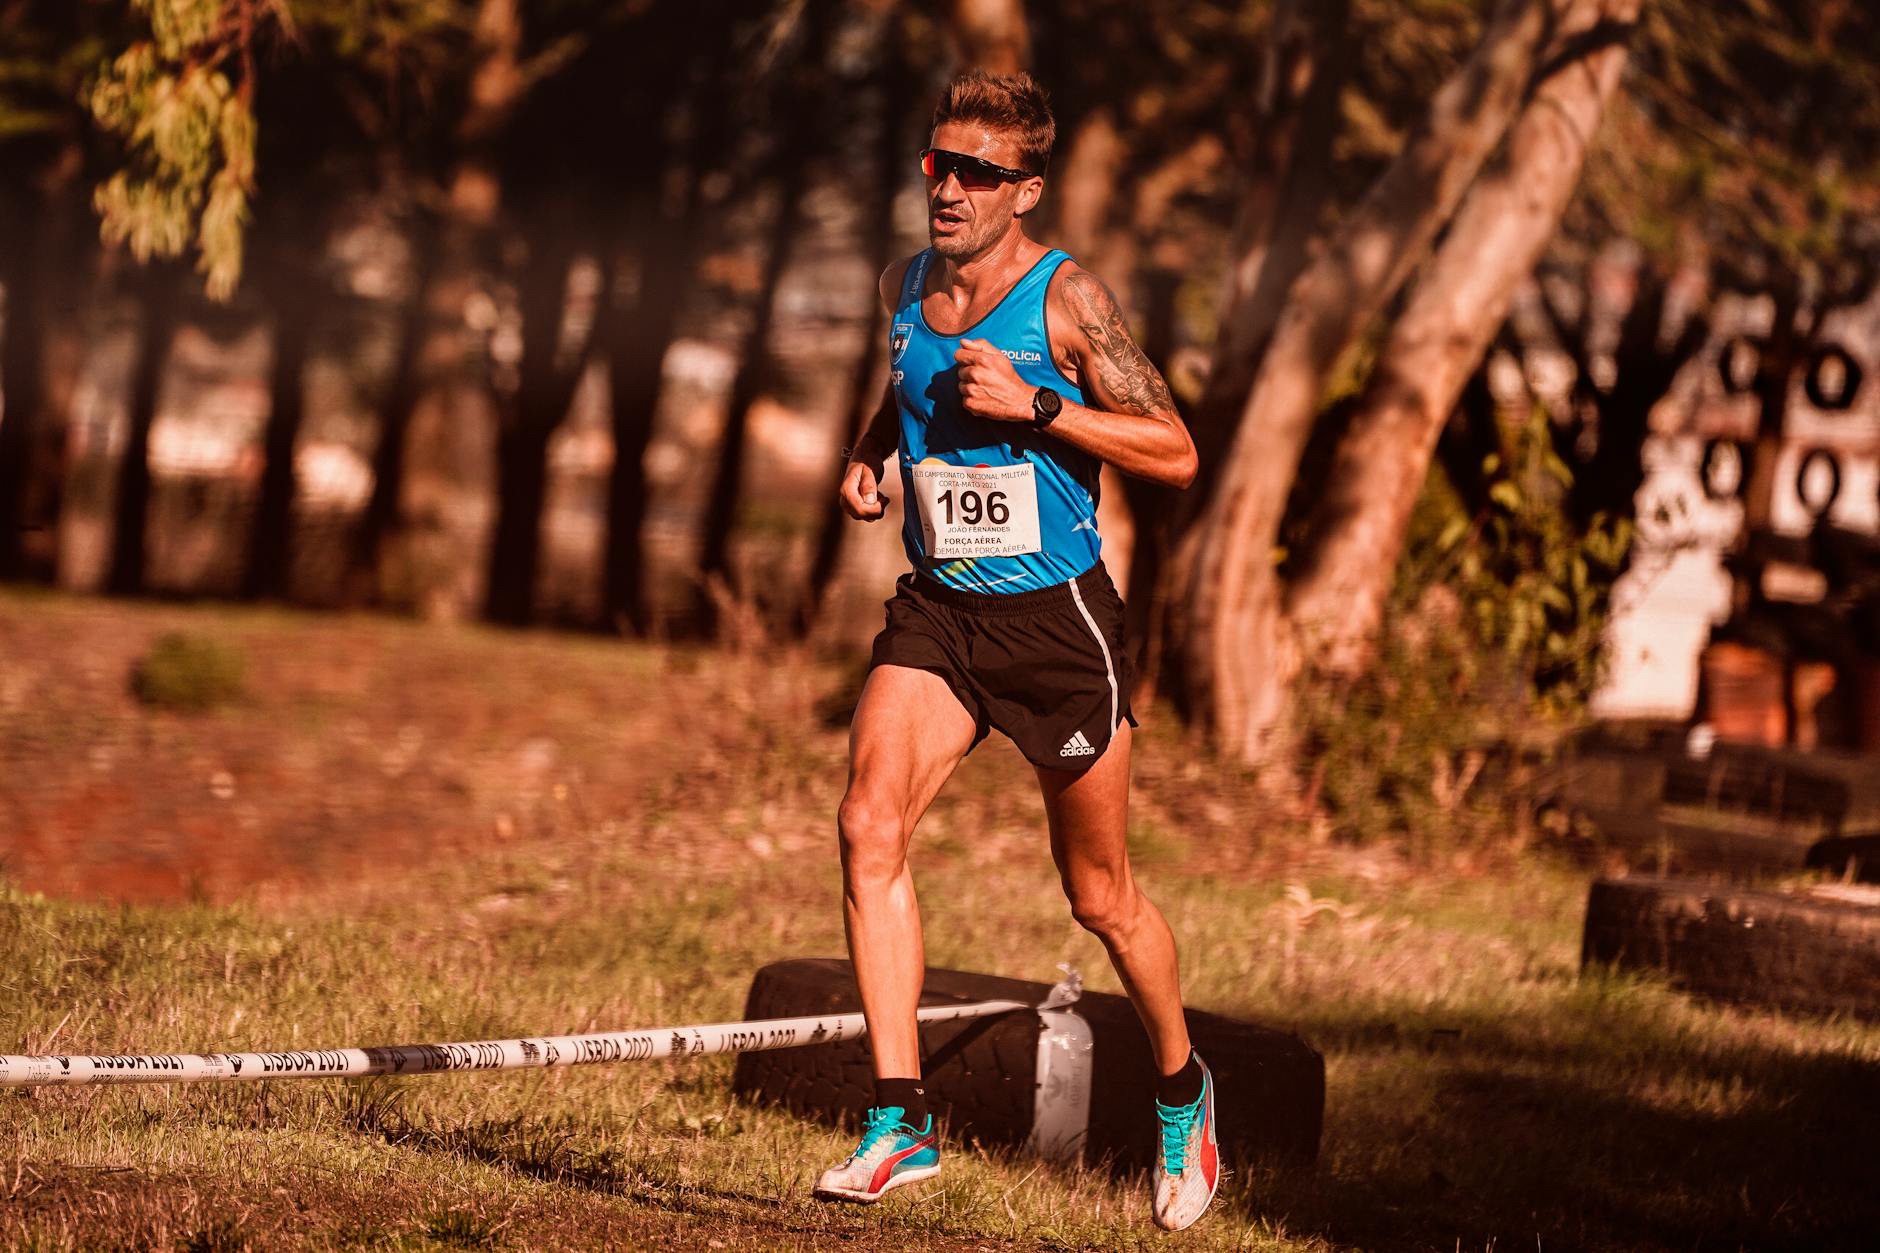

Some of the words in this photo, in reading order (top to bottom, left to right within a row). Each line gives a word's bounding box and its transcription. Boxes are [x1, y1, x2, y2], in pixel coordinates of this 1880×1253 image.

[925, 471, 964, 480] CAMPEONATO
[1001, 470, 1029, 480] MILITAR
[939, 480, 981, 488] CORTA-MATO
[937, 489, 1010, 525] 196
[948, 526, 967, 534] JOÃO
[944, 538, 972, 546] FORÇA
[974, 536, 1002, 545] AÉREA
[962, 547, 973, 555] DA
[975, 546, 1001, 555] FORÇA
[1002, 544, 1027, 554] AÉREA
[1059, 746, 1096, 757] adidas
[572, 1039, 621, 1065] LISBOA
[623, 1036, 654, 1062] 2021
[417, 1044, 472, 1070] LISBOA
[470, 1043, 505, 1068] 2021
